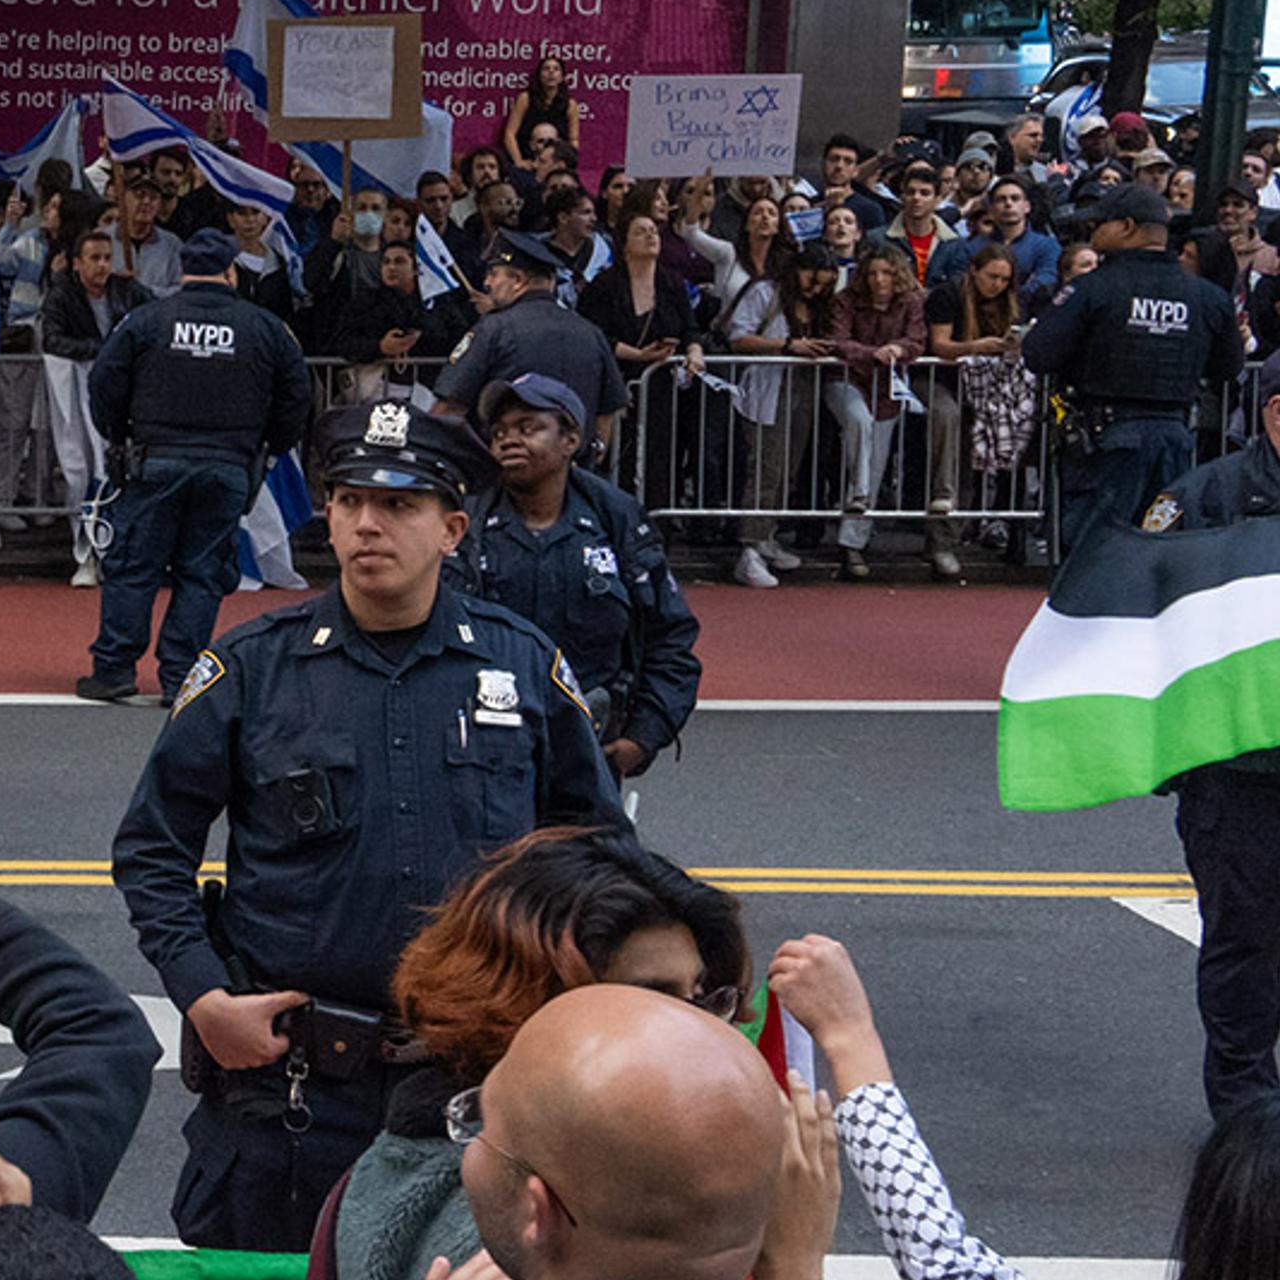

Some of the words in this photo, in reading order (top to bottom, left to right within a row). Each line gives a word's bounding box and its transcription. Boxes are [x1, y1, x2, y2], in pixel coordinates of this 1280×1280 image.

[46, 29, 132, 58] helping
[139, 33, 162, 53] to
[420, 37, 449, 58] nd
[456, 38, 533, 60] enable
[539, 38, 612, 63] faster,
[17, 89, 54, 108] not
[482, 100, 496, 118] a
[655, 81, 729, 114] Bring
[1131, 297, 1188, 323] NYPD
[173, 321, 235, 348] NYPD
